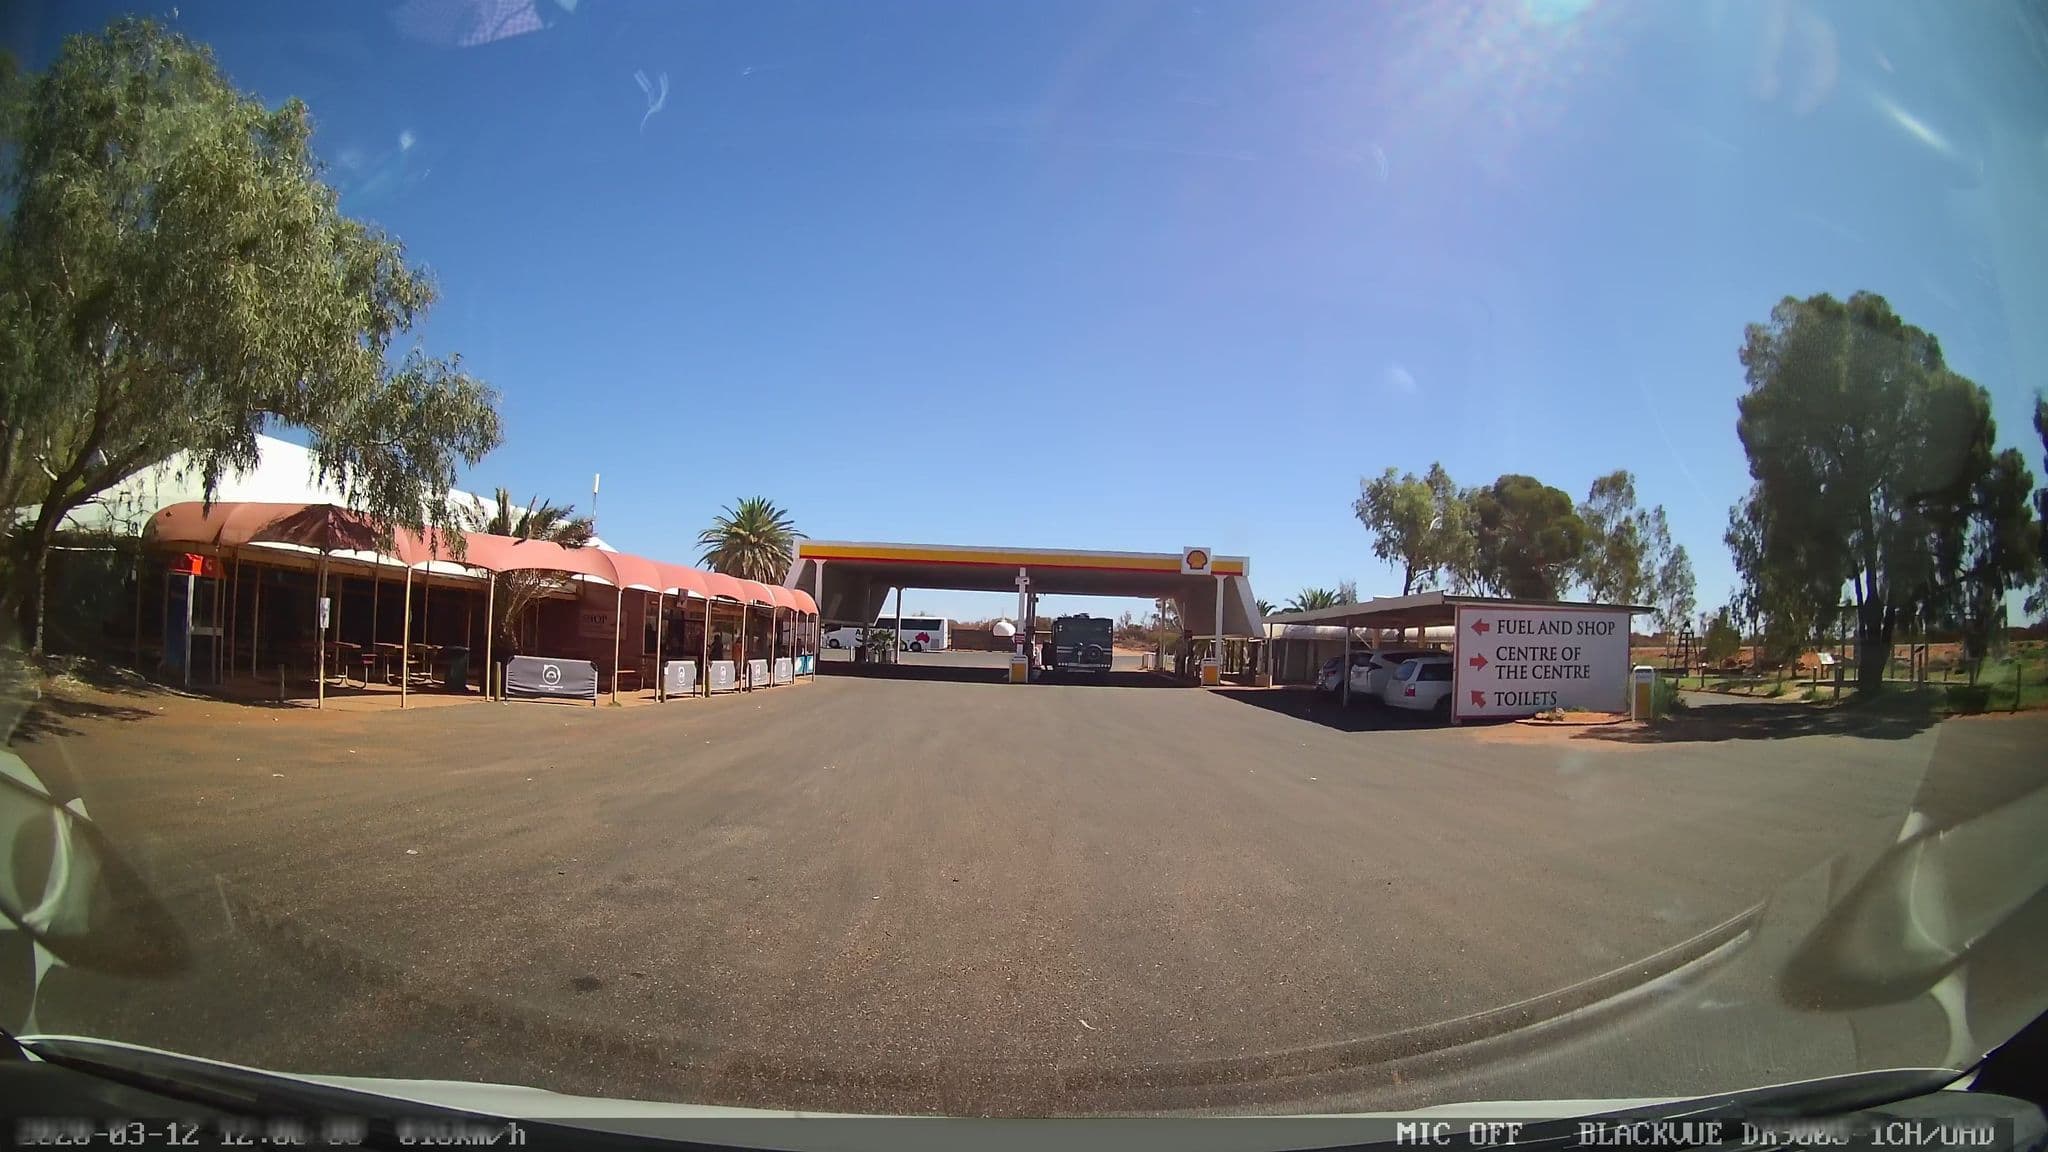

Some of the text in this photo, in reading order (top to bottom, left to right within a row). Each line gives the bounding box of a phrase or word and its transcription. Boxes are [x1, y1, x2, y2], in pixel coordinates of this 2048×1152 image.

[1497, 620, 1616, 636] FUEL AND SHOP
[1496, 646, 1582, 661] CENTRE OF
[1495, 665, 1590, 680] THE CENTRE
[1494, 691, 1557, 706] TOILETS
